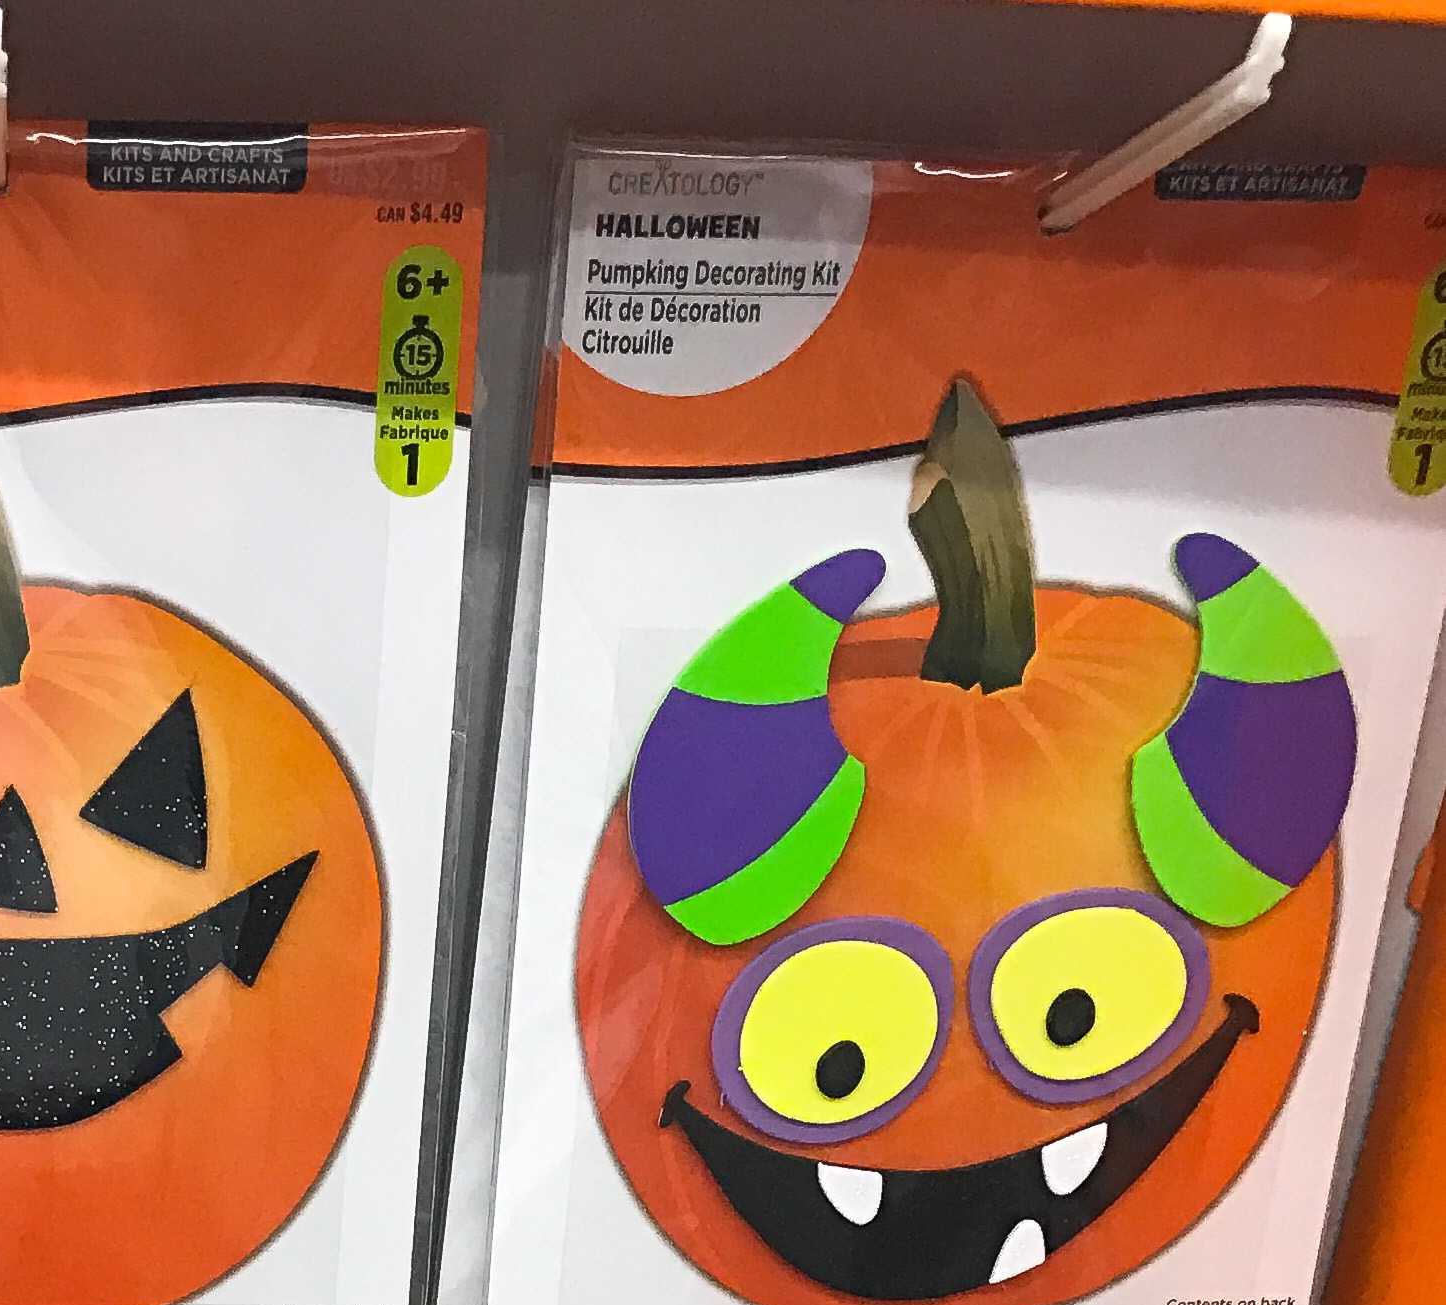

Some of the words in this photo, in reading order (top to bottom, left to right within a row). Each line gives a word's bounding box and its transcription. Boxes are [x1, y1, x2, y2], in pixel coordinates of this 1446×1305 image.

[111, 146, 153, 162] KITS
[158, 147, 201, 163] AND
[207, 147, 284, 165] CRAFTS
[103, 167, 147, 183] KITS
[152, 168, 173, 183] ET
[179, 168, 291, 185] ARTISANAT
[377, 206, 405, 223] CAN
[410, 202, 464, 225] $4.49
[595, 213, 760, 240] HALLOWEEN
[396, 264, 450, 300] 6+
[587, 259, 688, 289] Pumpking
[695, 260, 805, 291] Decorating
[812, 261, 841, 286] Kit
[405, 344, 432, 367] 15
[384, 378, 450, 396] minutes
[391, 405, 439, 422] Makes
[380, 425, 448, 443] Fabrique
[401, 443, 420, 486] 1
